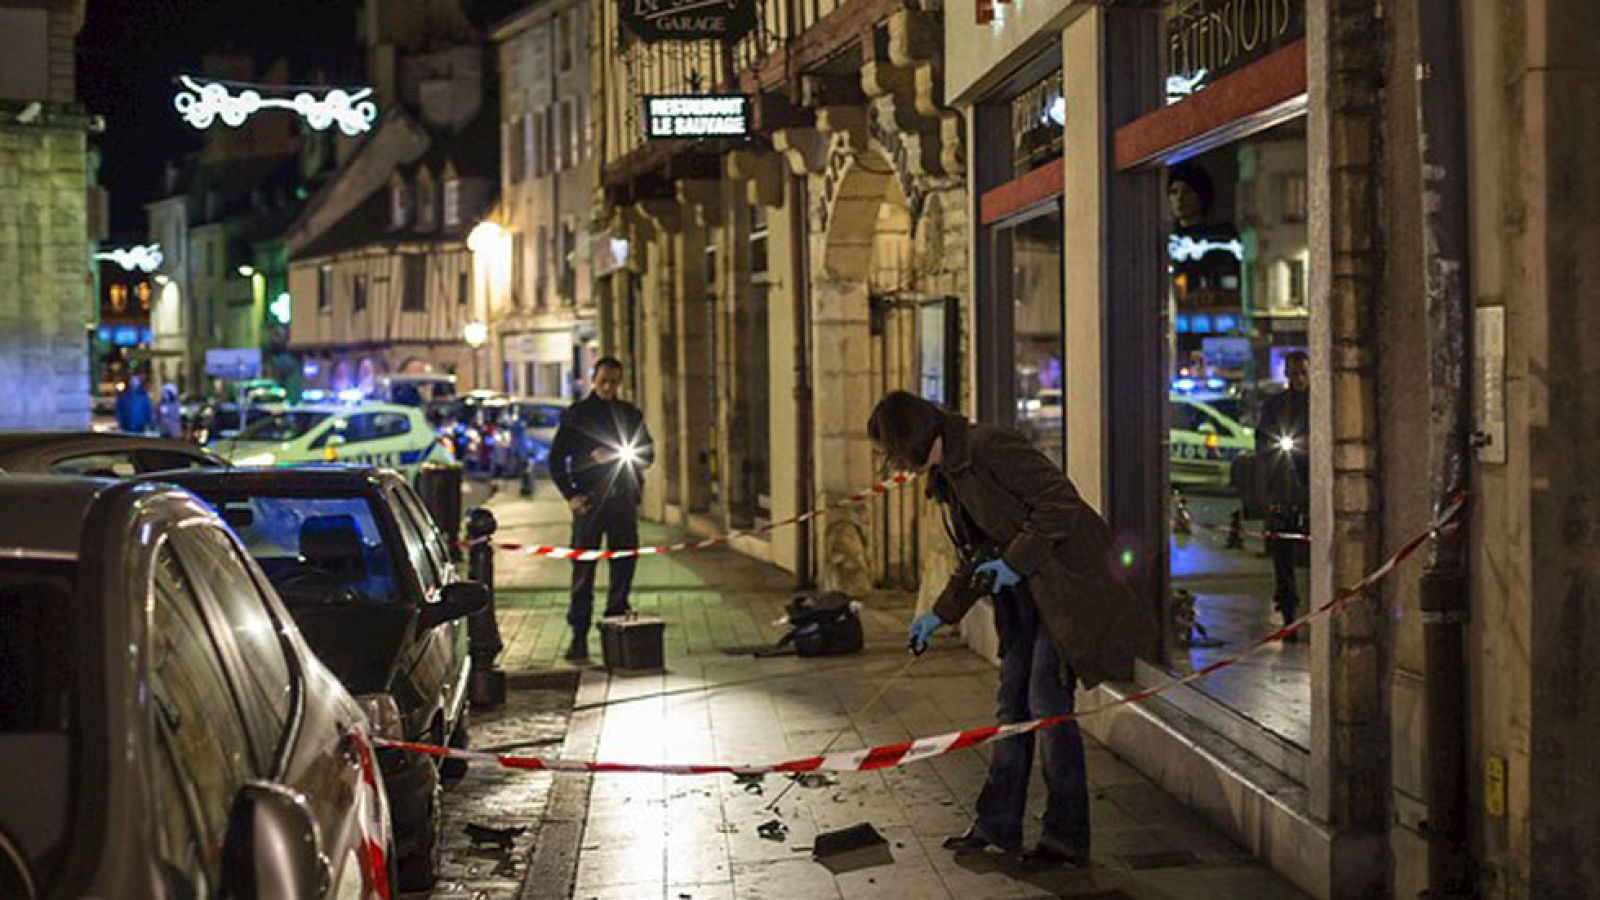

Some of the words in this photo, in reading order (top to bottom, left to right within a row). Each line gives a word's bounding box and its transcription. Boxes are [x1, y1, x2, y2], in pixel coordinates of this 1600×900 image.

[656, 16, 727, 32] GARAGE
[652, 116, 673, 136] LE
[675, 116, 745, 135] SAUVAGE
